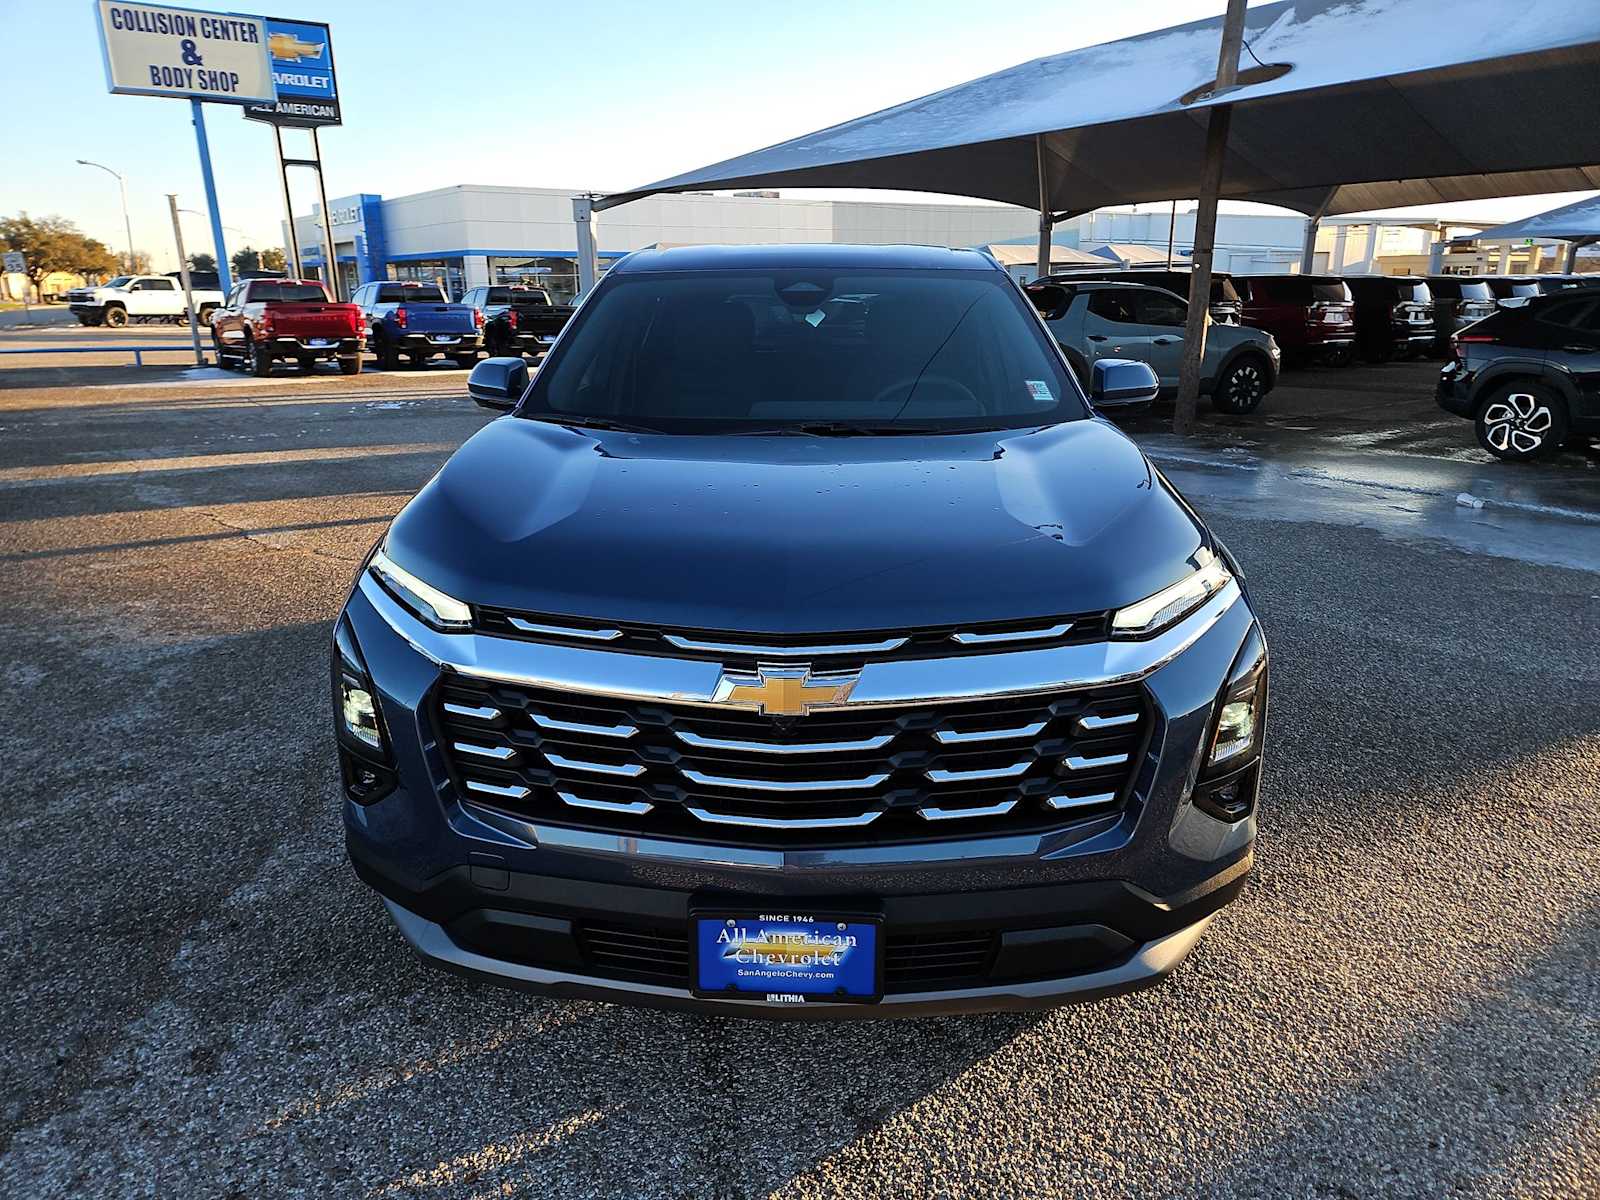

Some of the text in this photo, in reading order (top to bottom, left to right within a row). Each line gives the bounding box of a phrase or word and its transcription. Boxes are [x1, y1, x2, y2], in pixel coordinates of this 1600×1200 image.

[111, 7, 259, 43] COLLISION CENTER
[181, 39, 204, 66] &
[149, 65, 239, 93] BODY SHOP
[276, 102, 336, 117] AMERICAN
[759, 914, 814, 923] SINCE 1946
[716, 928, 857, 947] All American
[736, 949, 842, 967] Chevrolet
[737, 968, 834, 979] SanAngeloChevy.com
